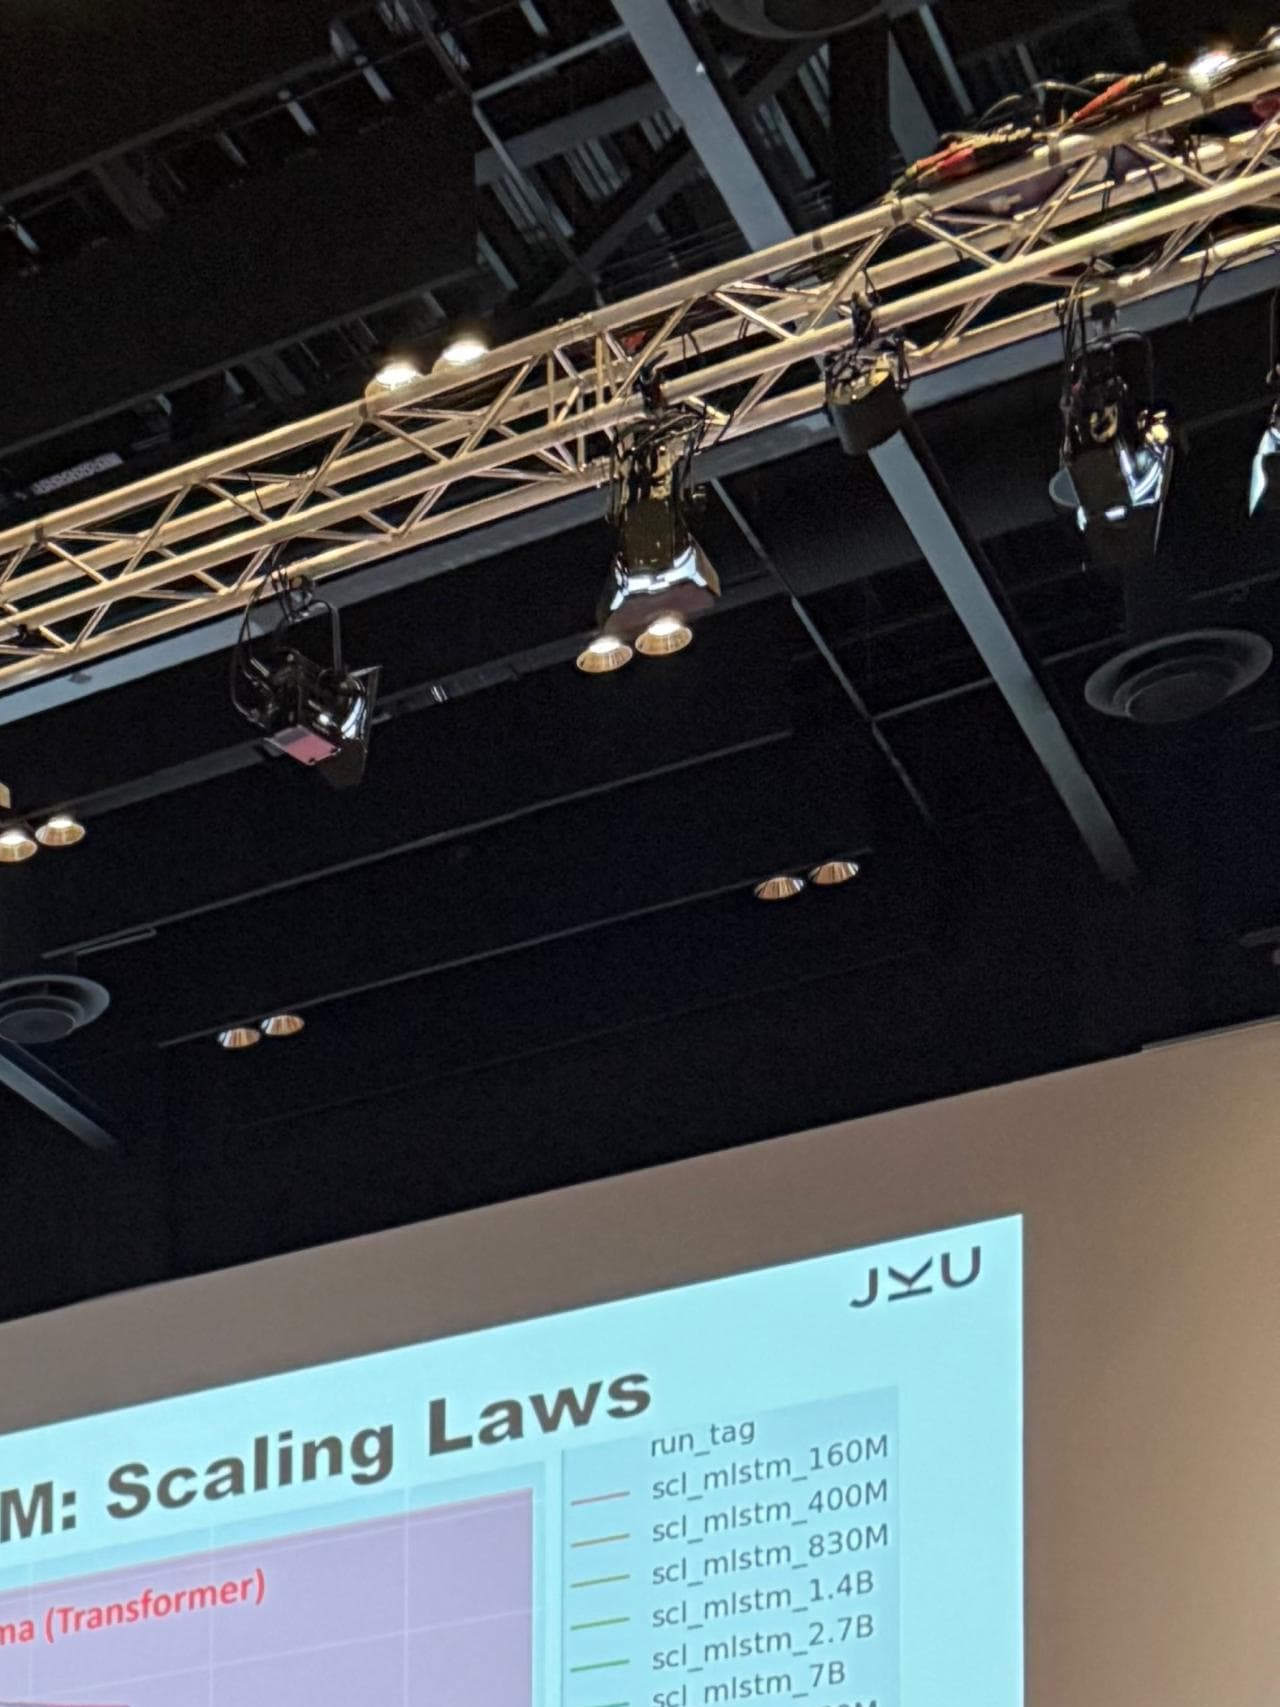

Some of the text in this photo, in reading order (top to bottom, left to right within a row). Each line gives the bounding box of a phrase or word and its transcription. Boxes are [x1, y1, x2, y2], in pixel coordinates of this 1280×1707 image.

[849, 1245, 981, 1309] JKU
[105, 1424, 394, 1520] Scaling
[428, 1372, 652, 1457] Laws
[650, 1421, 755, 1457] run_tag
[652, 1434, 888, 1501] scl_mlstm_160M
[652, 1479, 888, 1544] scl_mlstm_400M
[652, 1523, 889, 1588] scl_mlstm_830M
[45, 1567, 266, 1644] (Transformer)
[652, 1570, 874, 1630] scl_mlstm_1.4B
[652, 1614, 874, 1673] scl_mlstm_2.7B
